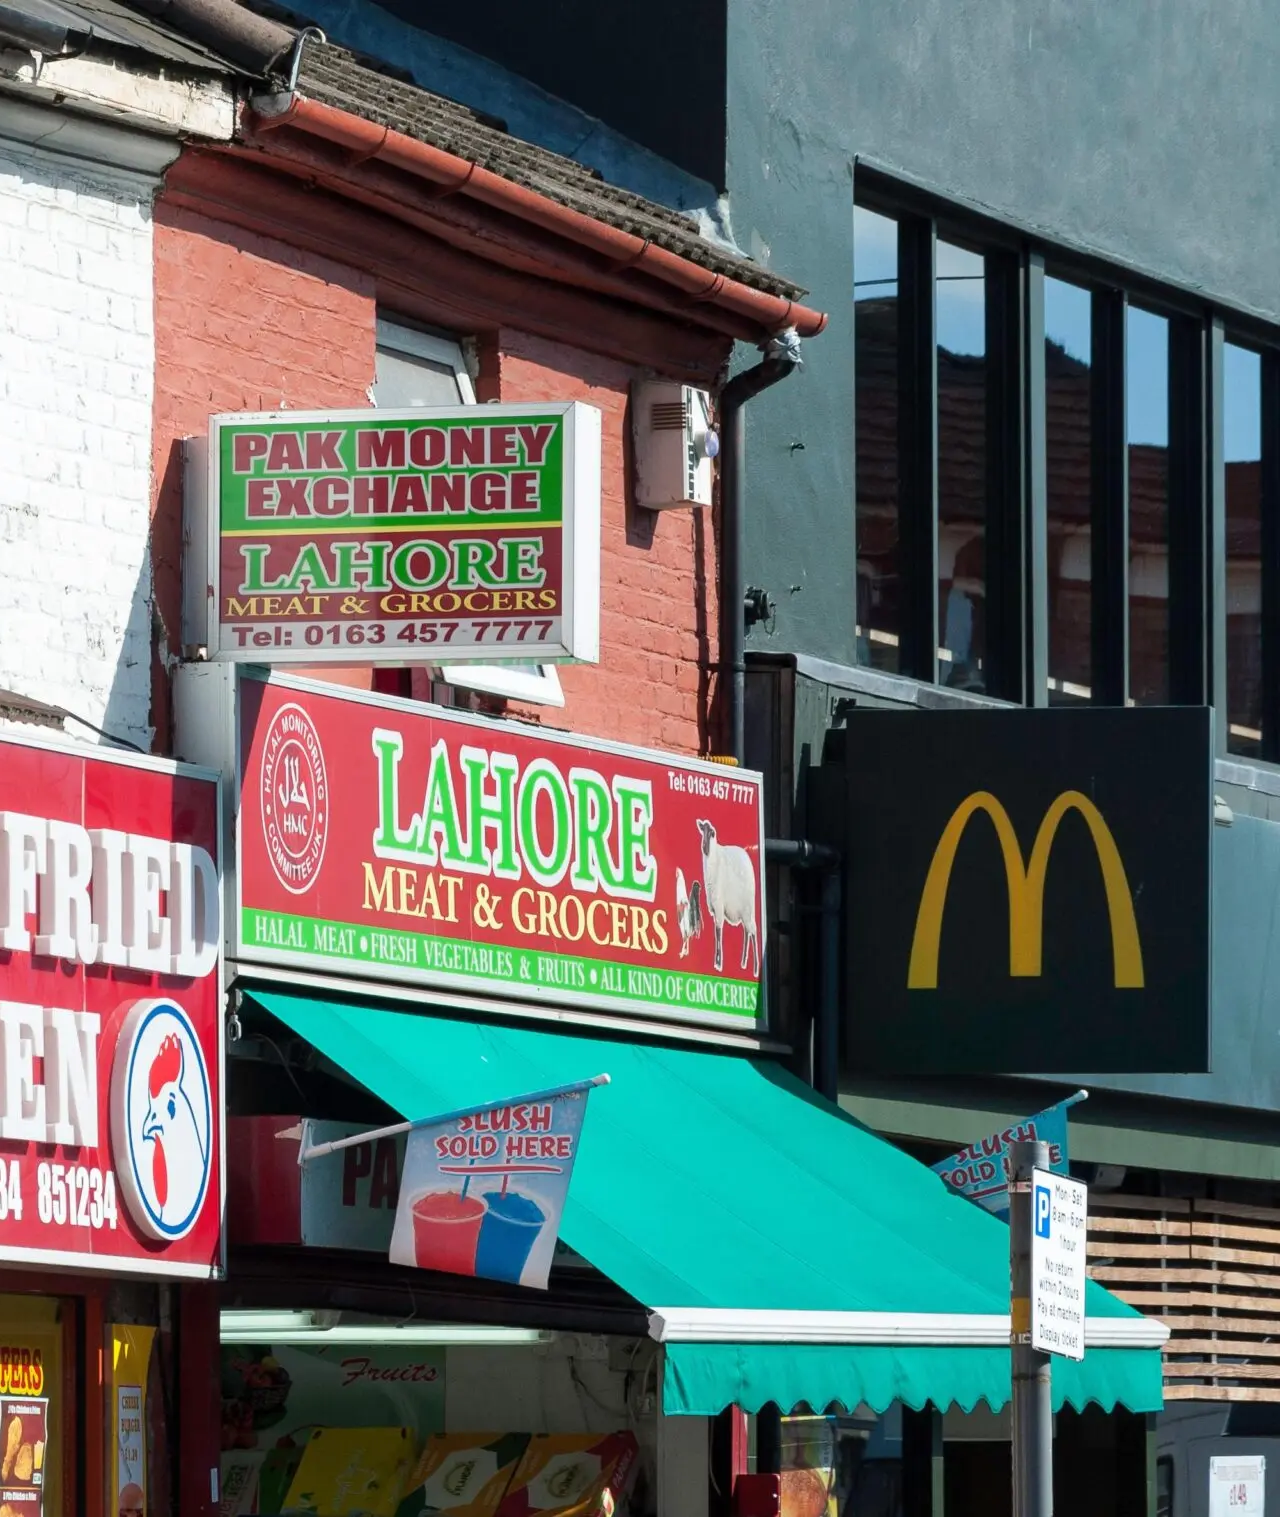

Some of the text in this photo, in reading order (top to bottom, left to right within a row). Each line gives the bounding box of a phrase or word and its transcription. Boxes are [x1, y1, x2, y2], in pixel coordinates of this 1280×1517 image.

[233, 423, 557, 474] PAK MONEY
[246, 471, 540, 520] EXCHANGE
[239, 537, 546, 594] LAHORE
[225, 589, 557, 619] MEAT & GROCERS
[232, 620, 554, 648] Tel: 0163 457 7777
[264, 714, 325, 800] HALAL MONITORING
[668, 771, 755, 805] Tel: 0163 457 7777
[283, 812, 308, 836] HMC
[372, 727, 658, 902] LAHORE
[361, 862, 669, 955] MEAT & GROCERS
[255, 915, 758, 1013] HALAL MEAT FRESH VEGETABLES & FRUITS ALL KIND OF GROCERIES
[435, 1134, 572, 1160] SOLD HERE
[37, 1164, 117, 1230] 851234
[1045, 1257, 1074, 1277] No return
[1039, 1279, 1057, 1293] within
[1063, 1285, 1079, 1301] hours
[1038, 1297, 1048, 1317] Pay
[1057, 1306, 1080, 1324] machine
[1039, 1323, 1078, 1349] Display ticket
[340, 1357, 439, 1388] Fruits
